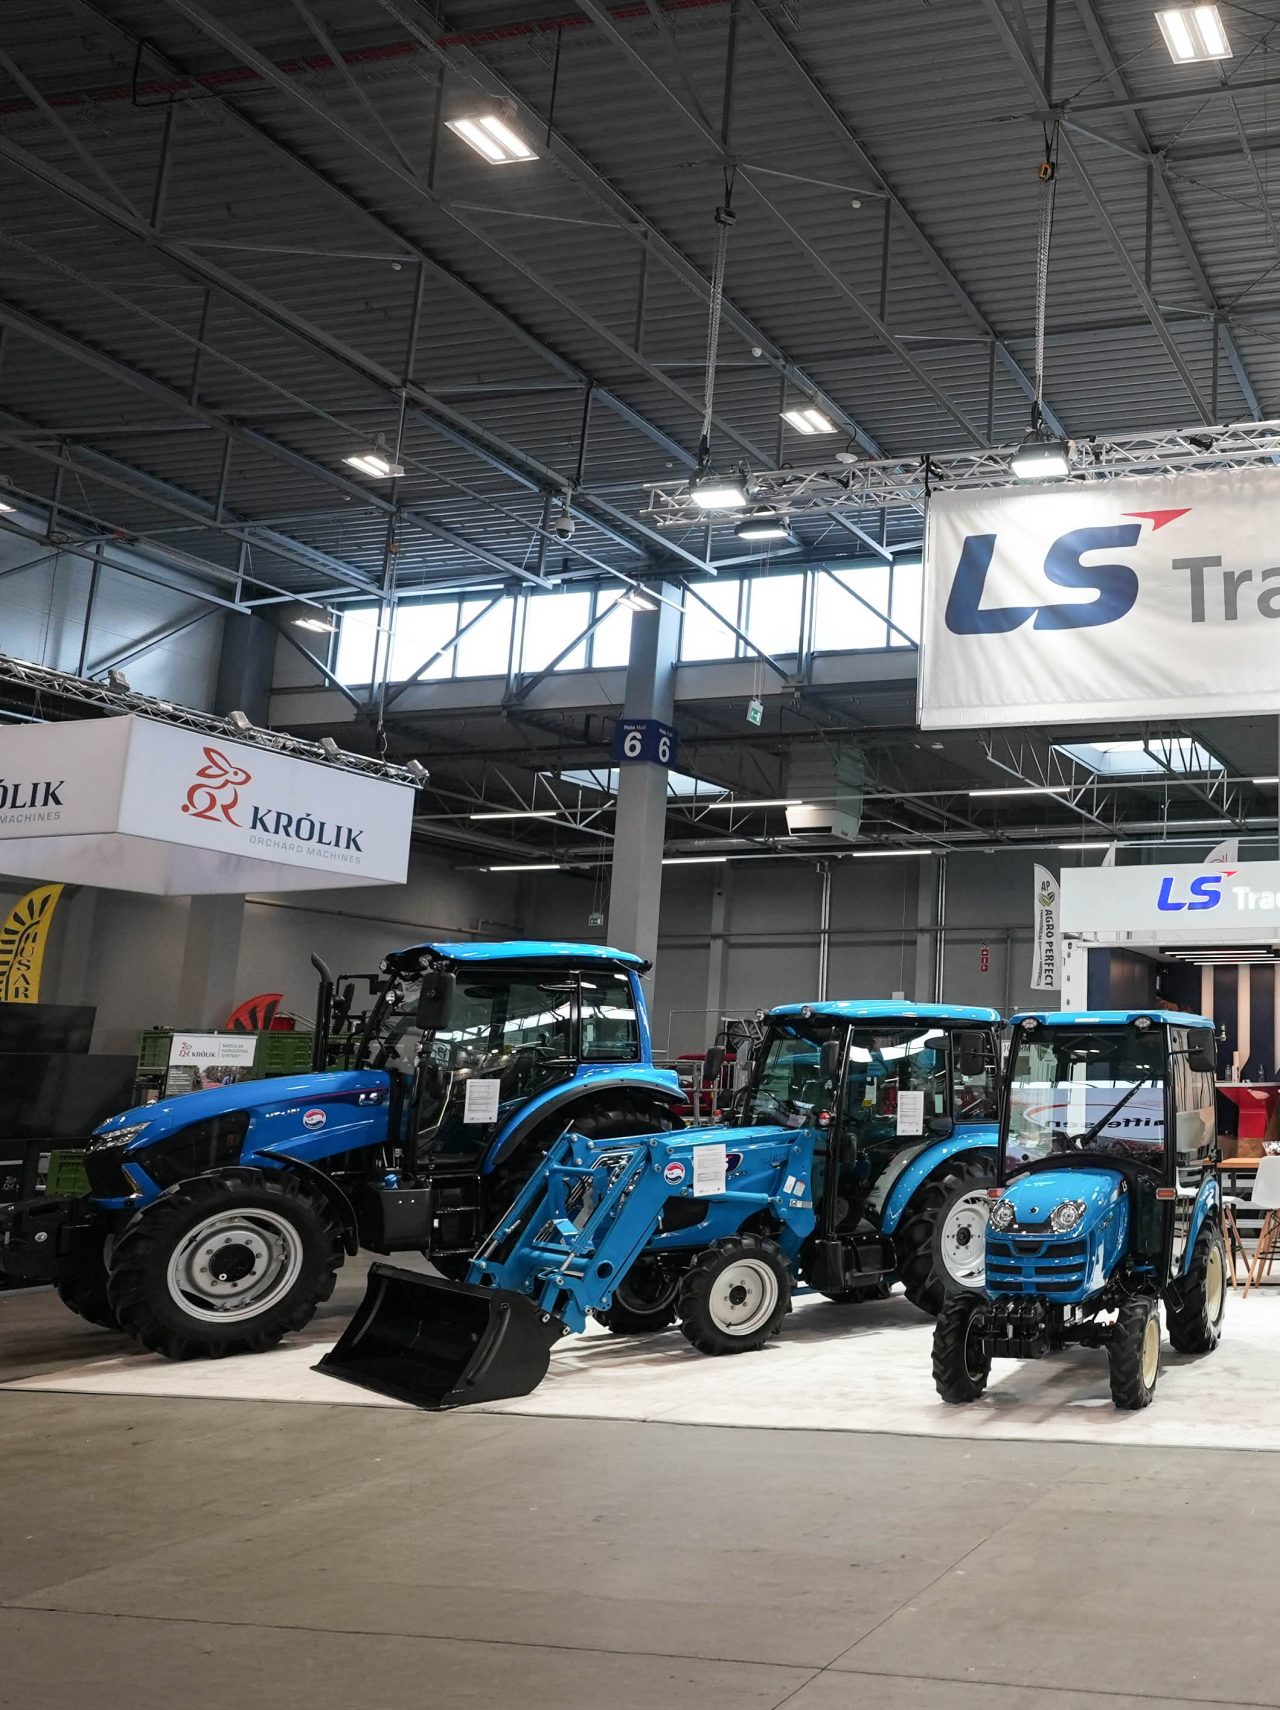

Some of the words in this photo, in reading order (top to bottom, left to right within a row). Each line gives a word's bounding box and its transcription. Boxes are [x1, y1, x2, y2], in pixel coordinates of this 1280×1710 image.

[945, 523, 1142, 635] LS
[624, 731, 642, 757] 6
[659, 736, 670, 763] 6
[249, 805, 364, 852] KRÓLIK
[250, 835, 303, 853] ORCHARD
[307, 847, 361, 864] MACHINES
[1157, 876, 1222, 911] LS
[1045, 909, 1055, 938] AGRO
[13, 932, 38, 999] HUSAR
[1044, 941, 1054, 987] PERFECT
